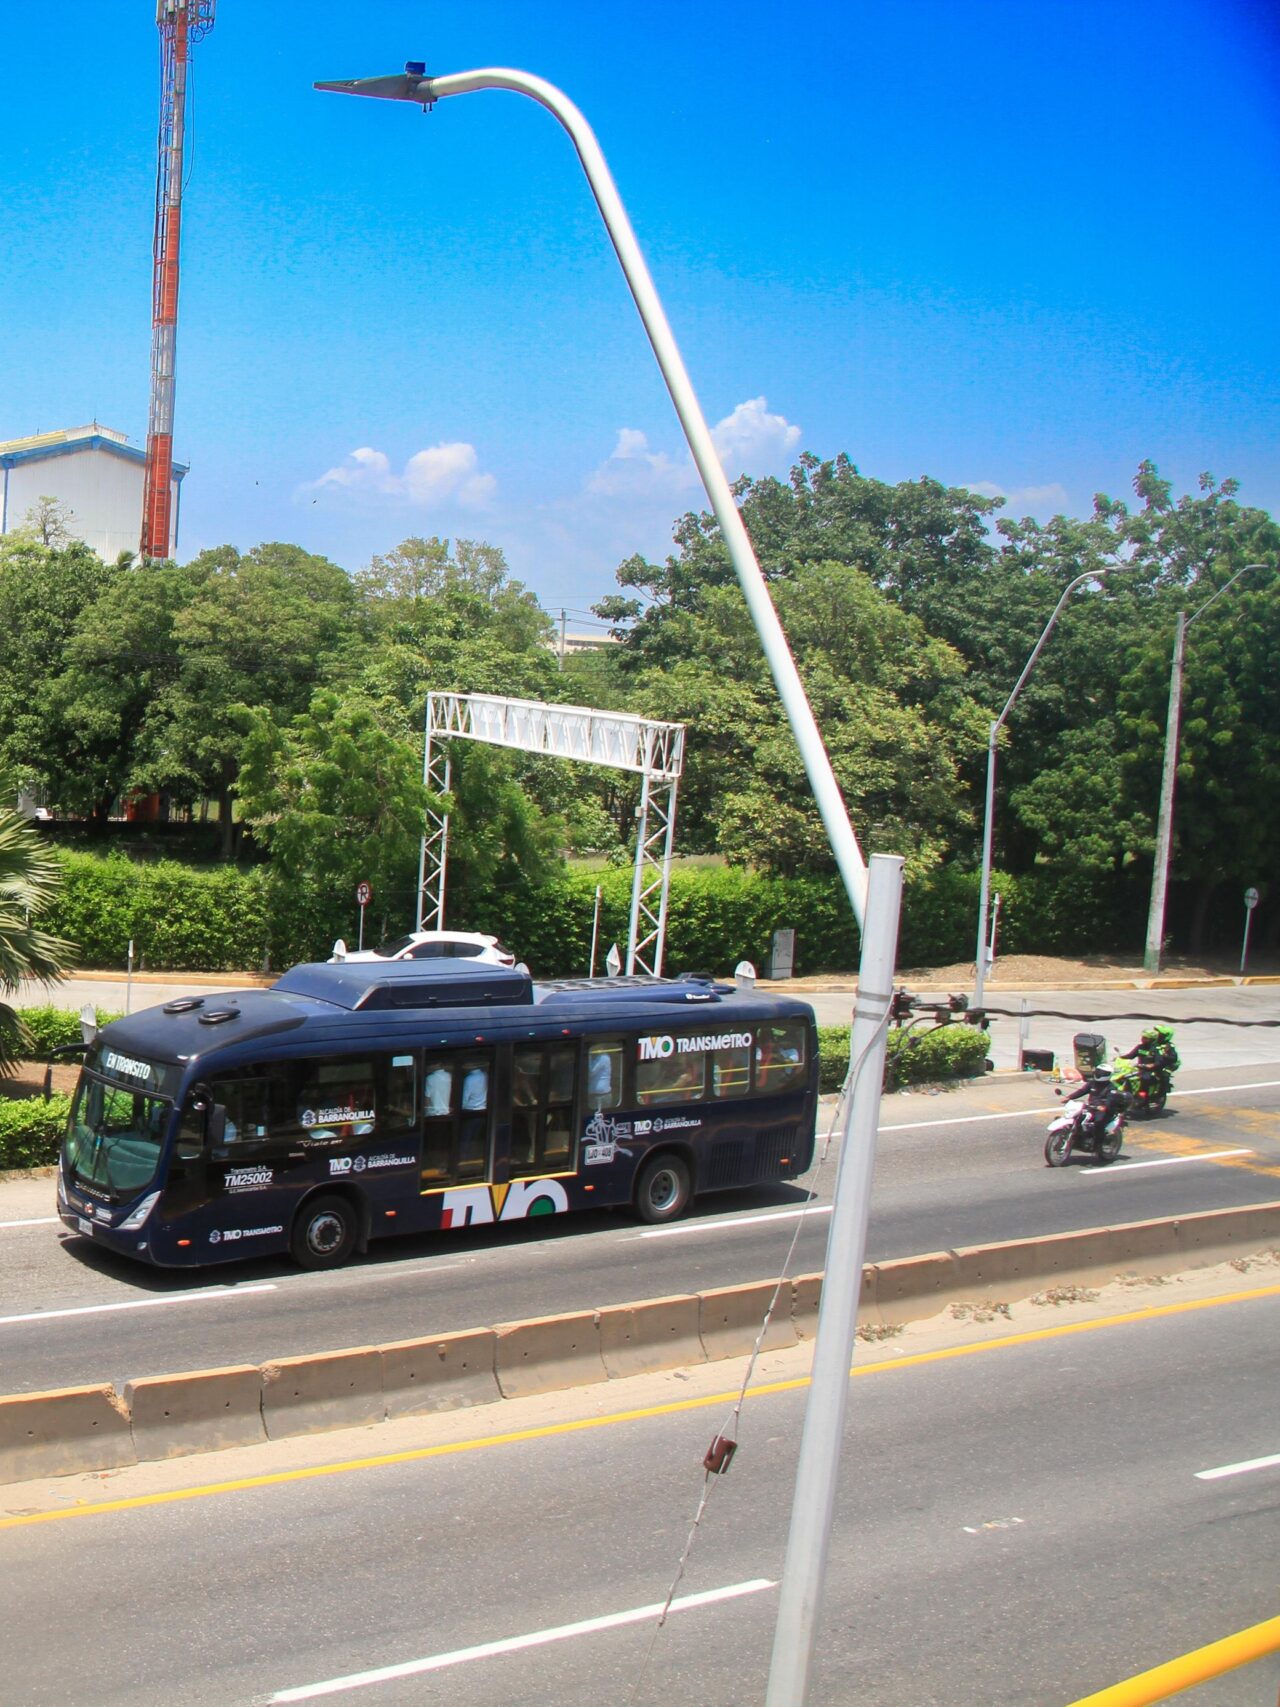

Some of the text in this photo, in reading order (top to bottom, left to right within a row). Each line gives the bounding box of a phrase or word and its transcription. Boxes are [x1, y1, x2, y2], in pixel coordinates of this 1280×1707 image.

[106, 1052, 151, 1080] EN TRANSITO
[318, 1110, 375, 1123] BARRANQUILLA
[367, 1156, 416, 1168] BARRANQUILLA
[224, 1172, 273, 1187] TM25002
